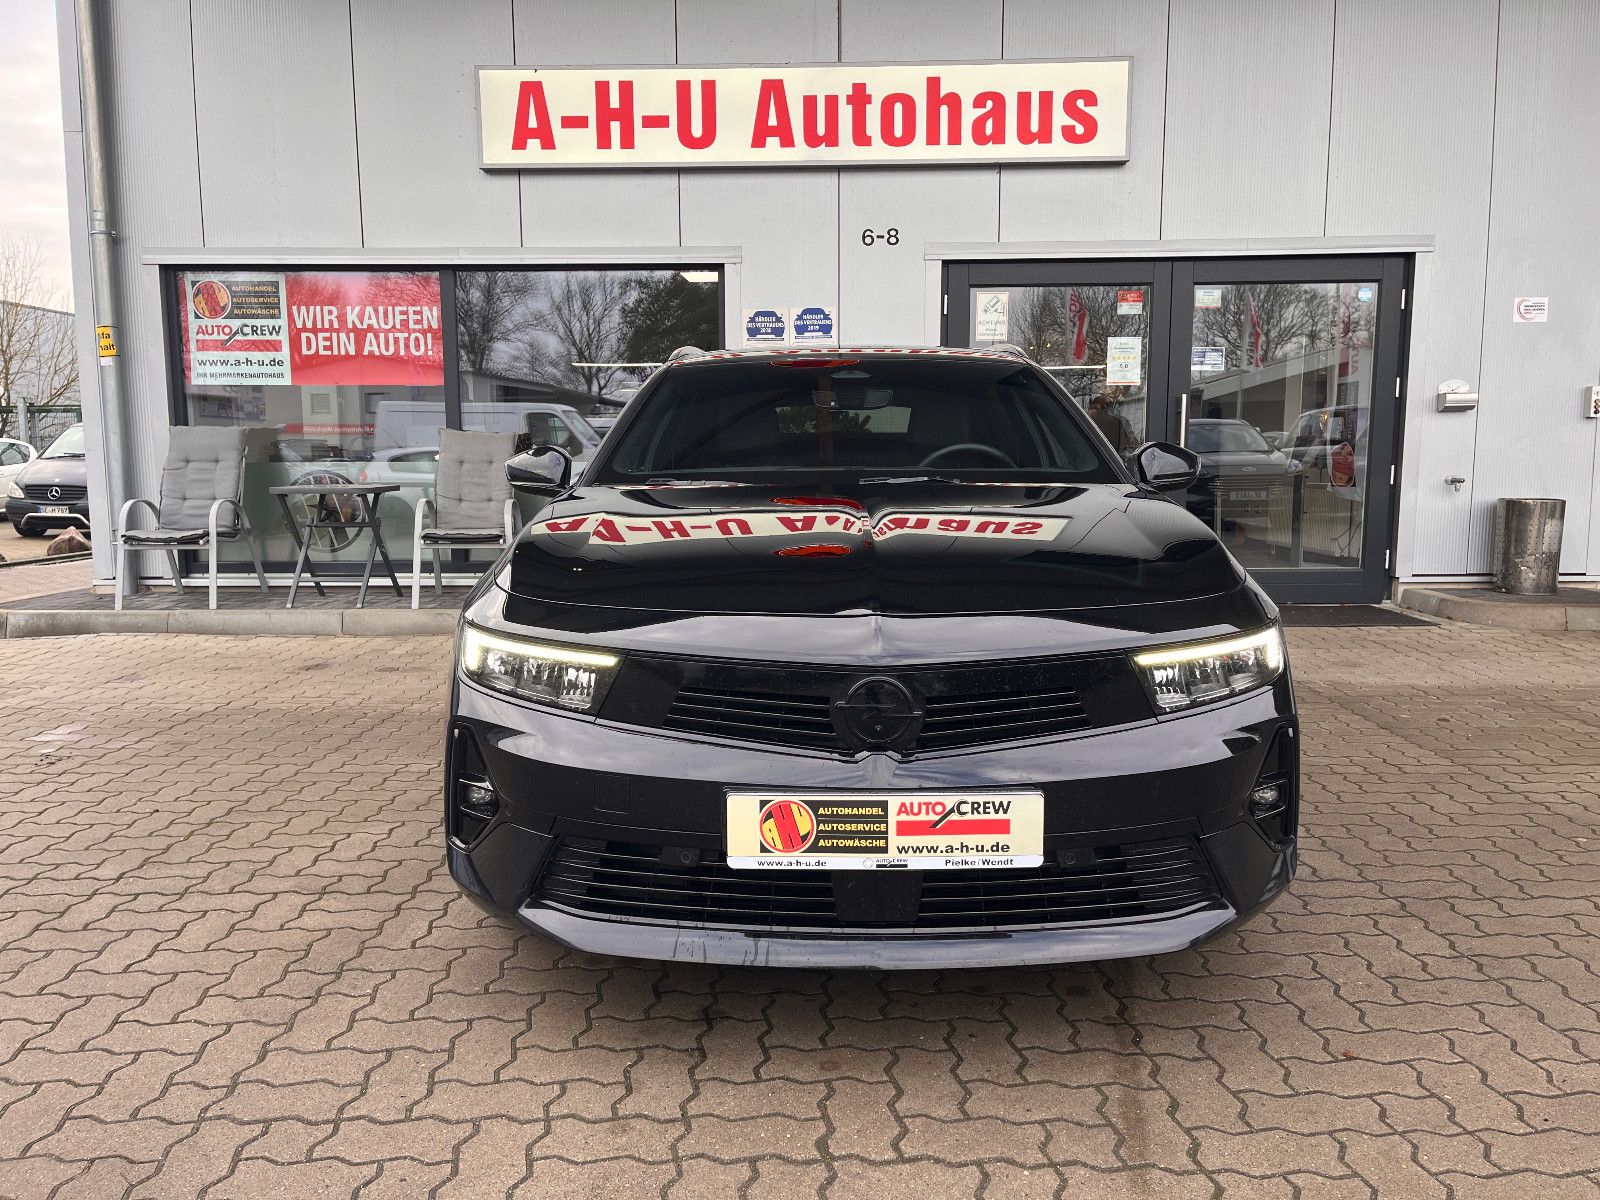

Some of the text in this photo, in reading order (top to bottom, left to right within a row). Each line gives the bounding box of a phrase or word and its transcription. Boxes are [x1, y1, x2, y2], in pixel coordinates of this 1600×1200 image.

[511, 75, 1100, 151] A-H-U Autohaus
[861, 227, 900, 247] 6-8
[291, 305, 439, 330] WIR KAUFEN
[195, 323, 282, 337] AUTO CREW
[300, 331, 434, 356] DEIN AUTO!
[197, 357, 285, 367] www.a-h-u.de
[817, 807, 885, 815] AUTOHANDEL
[896, 798, 1012, 817] AUTO CREW
[817, 823, 887, 831] AUTOSERVICE
[817, 838, 887, 847] AUTOWÄSCHE
[896, 841, 1011, 855] www.a-h-u.de
[756, 859, 827, 867] www.a-h-u.de
[944, 858, 1015, 867] Pielke/Wendt
